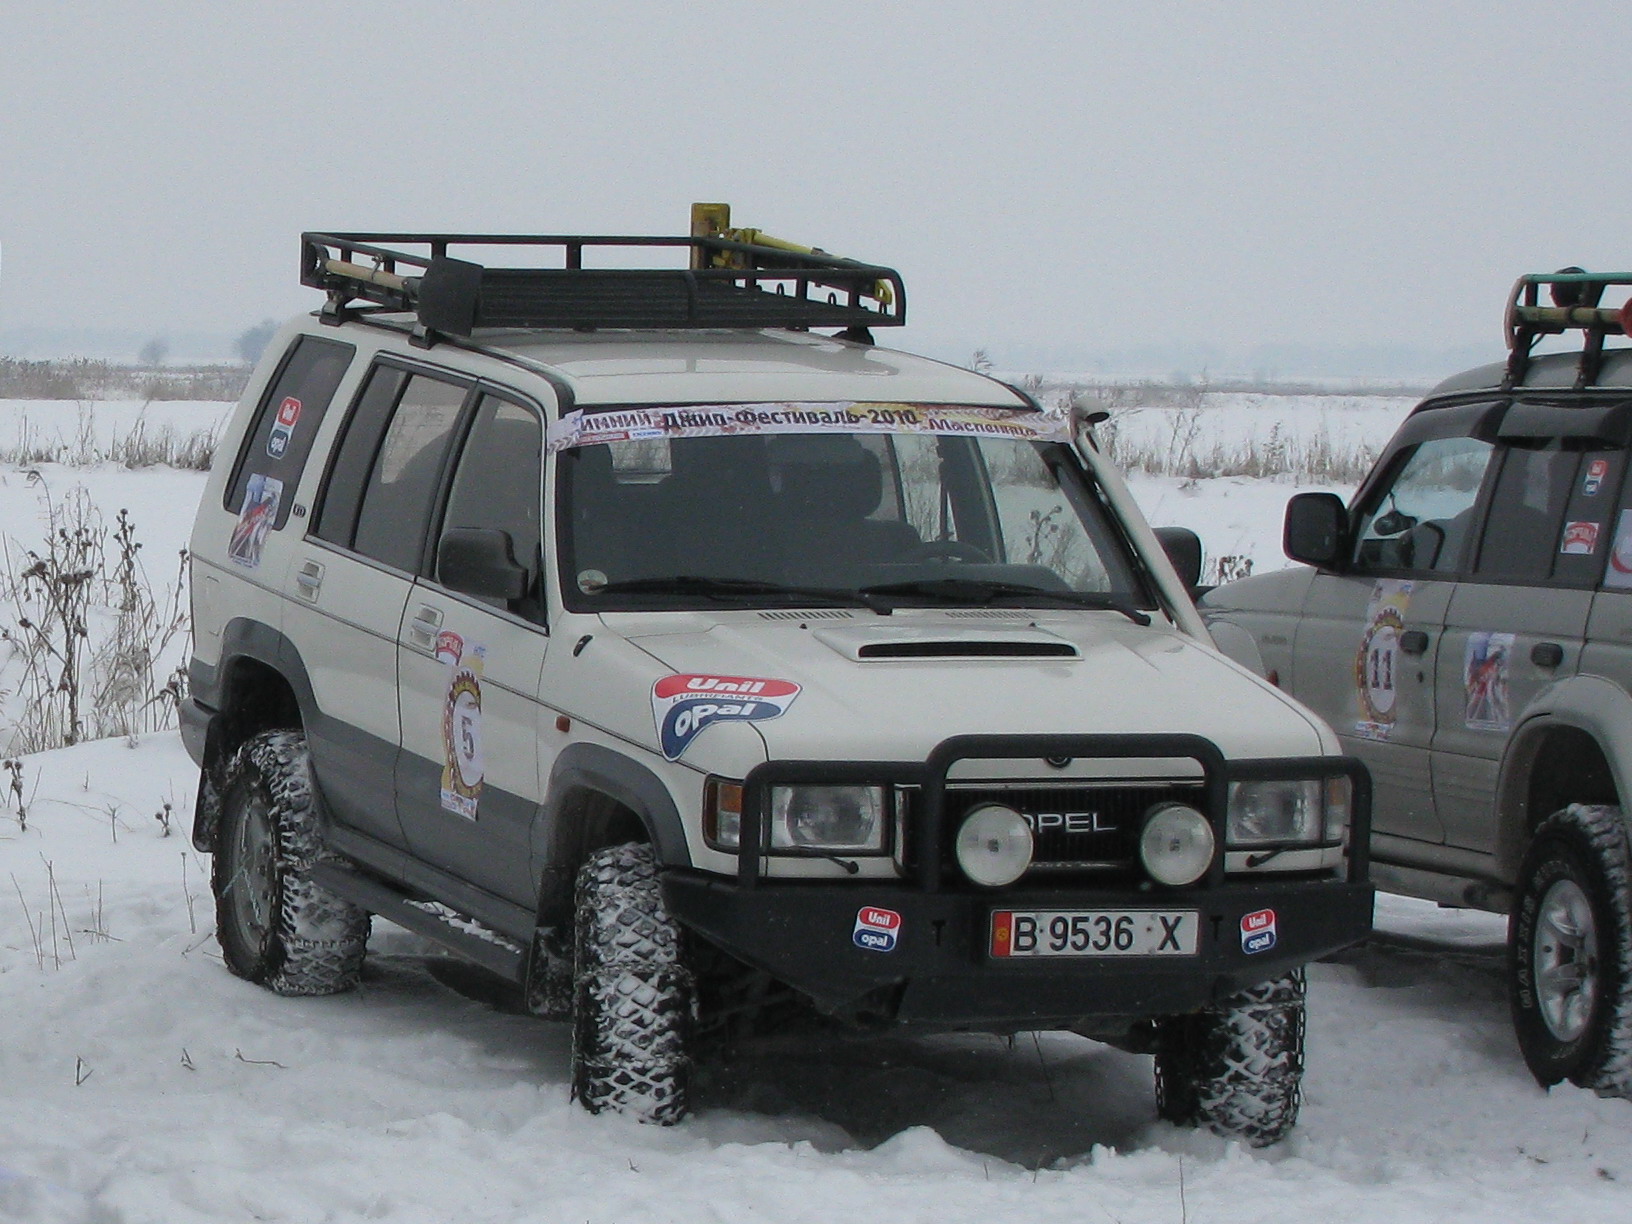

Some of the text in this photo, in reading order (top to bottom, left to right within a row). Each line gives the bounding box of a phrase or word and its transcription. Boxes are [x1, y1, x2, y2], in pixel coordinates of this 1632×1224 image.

[580, 411, 653, 432] ИМНИЙ
[1370, 648, 1393, 691] 11
[686, 677, 766, 694] Unil
[461, 715, 475, 761] 5
[868, 911, 891, 926] Unil
[1248, 912, 1267, 929] Unil
[861, 933, 888, 947] opal
[1013, 915, 1183, 952] B 9536 X
[1248, 933, 1271, 950] opal
